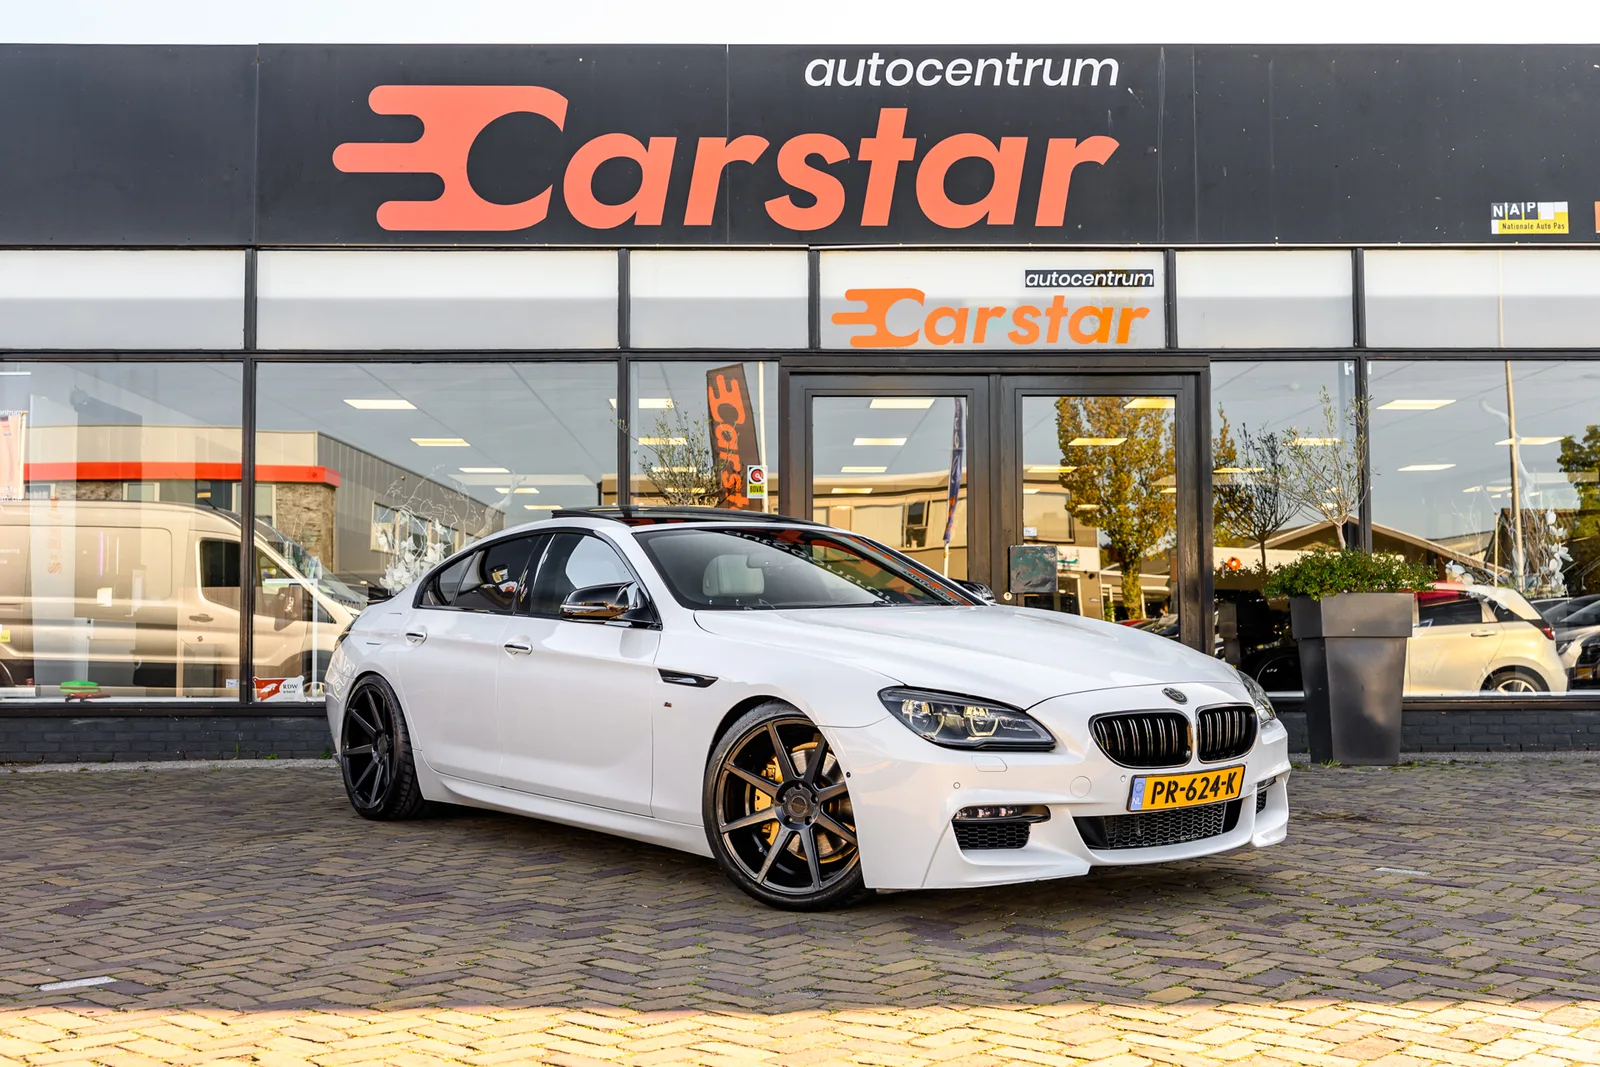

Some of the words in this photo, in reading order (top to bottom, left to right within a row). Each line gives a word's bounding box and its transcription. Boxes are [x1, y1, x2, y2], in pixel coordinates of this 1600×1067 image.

[804, 52, 1120, 88] autocentrum
[332, 85, 1119, 231] Carstar
[1493, 202, 1536, 218] NAP
[1502, 222, 1534, 230] Nationale
[1536, 222, 1552, 230] Auto
[1026, 271, 1154, 287] autocentrum
[831, 288, 1150, 347] Carstar
[708, 374, 749, 510] Carst
[1131, 797, 1142, 805] NL
[1151, 772, 1238, 804] PR-624-K
